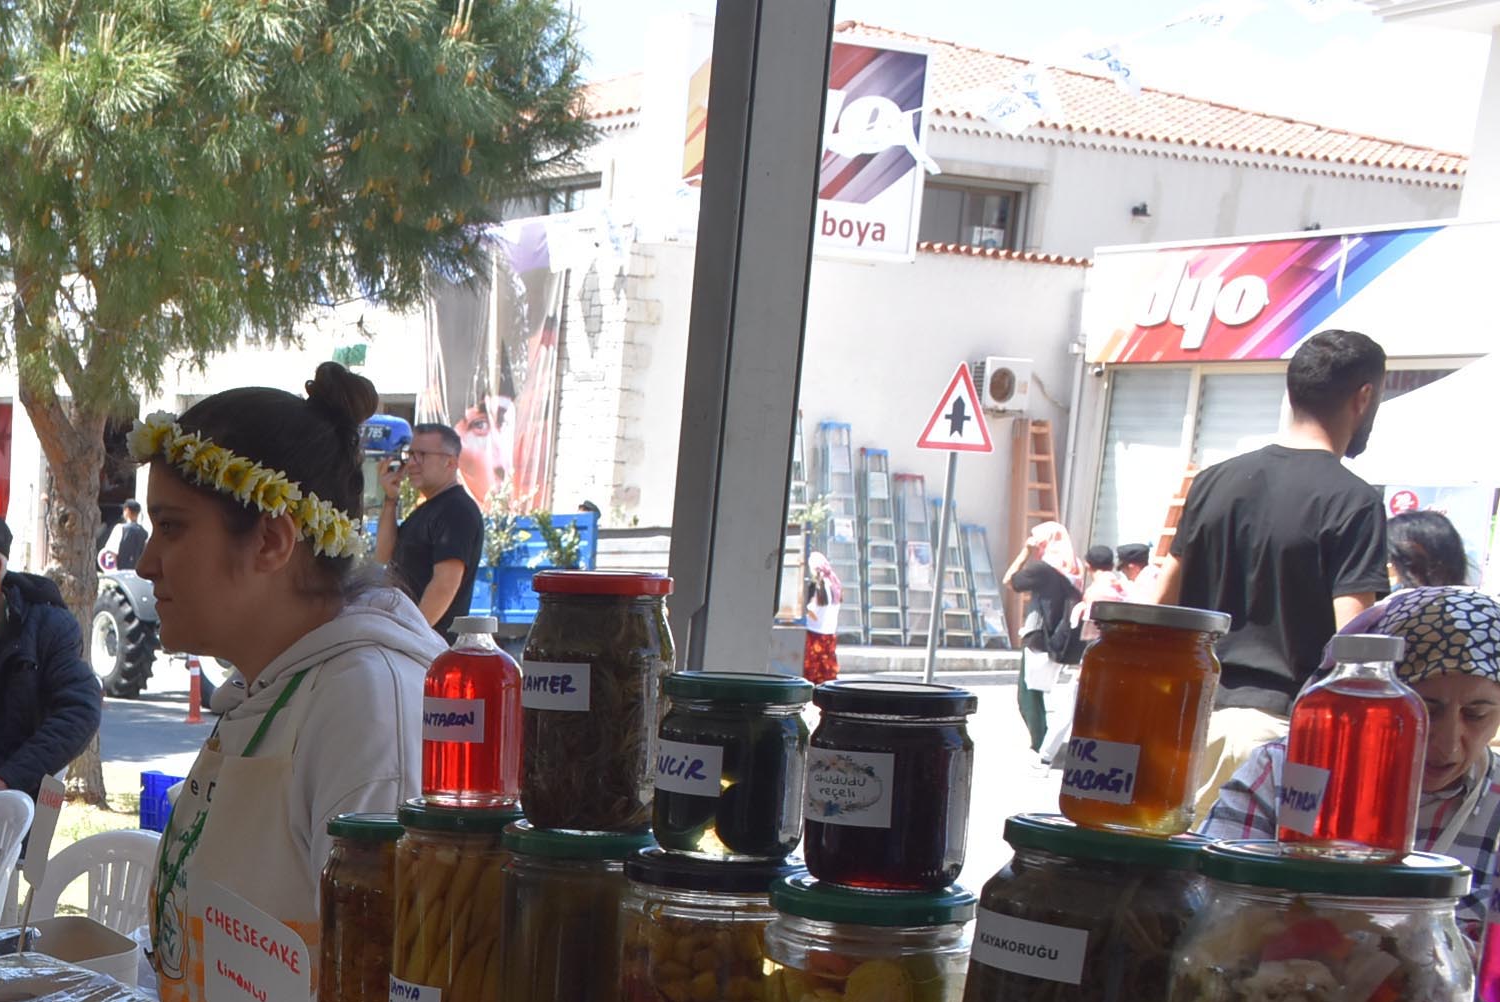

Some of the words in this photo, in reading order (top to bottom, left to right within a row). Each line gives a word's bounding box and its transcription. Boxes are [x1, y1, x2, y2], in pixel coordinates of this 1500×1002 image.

[821, 210, 886, 247] boya
[1134, 260, 1269, 350] dyo
[205, 905, 301, 975] CHEESECAKE
[980, 931, 1059, 960] KAYAKORUĞU
